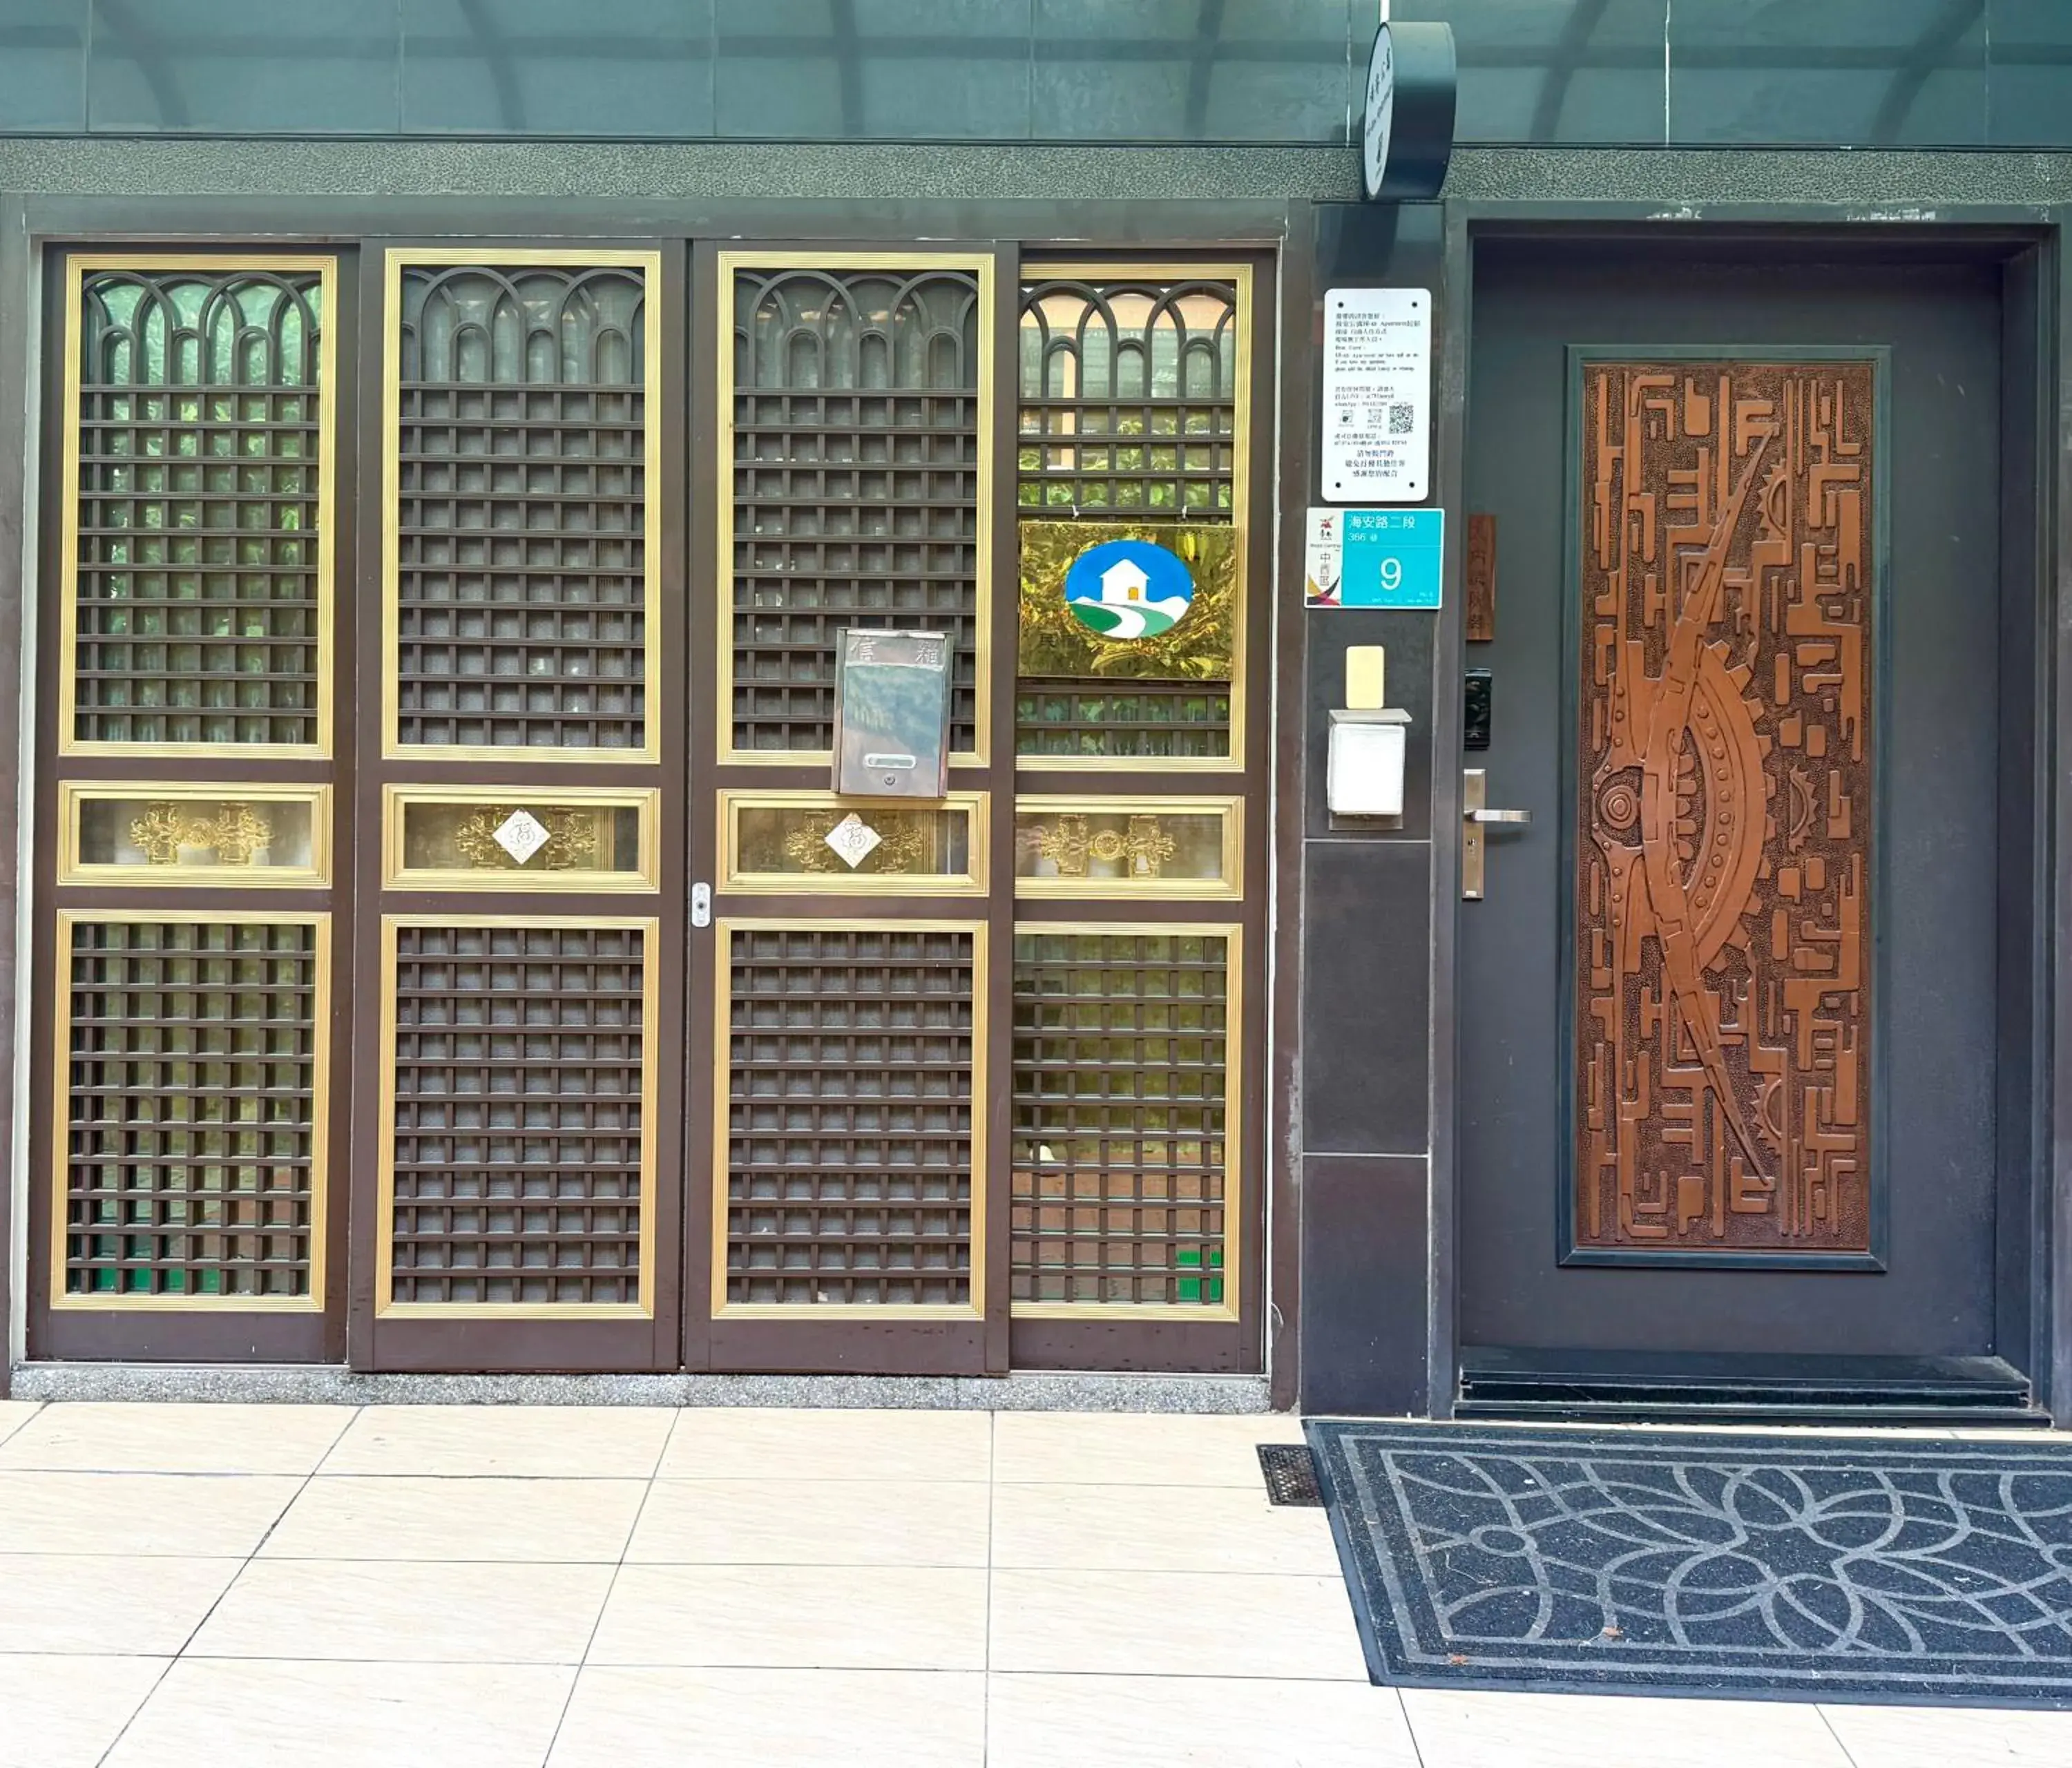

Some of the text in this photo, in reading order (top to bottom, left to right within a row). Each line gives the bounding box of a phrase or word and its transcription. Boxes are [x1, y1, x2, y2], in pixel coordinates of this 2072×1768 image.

[1348, 515, 1415, 529] 海安路二段
[1380, 557, 1402, 590] 9
